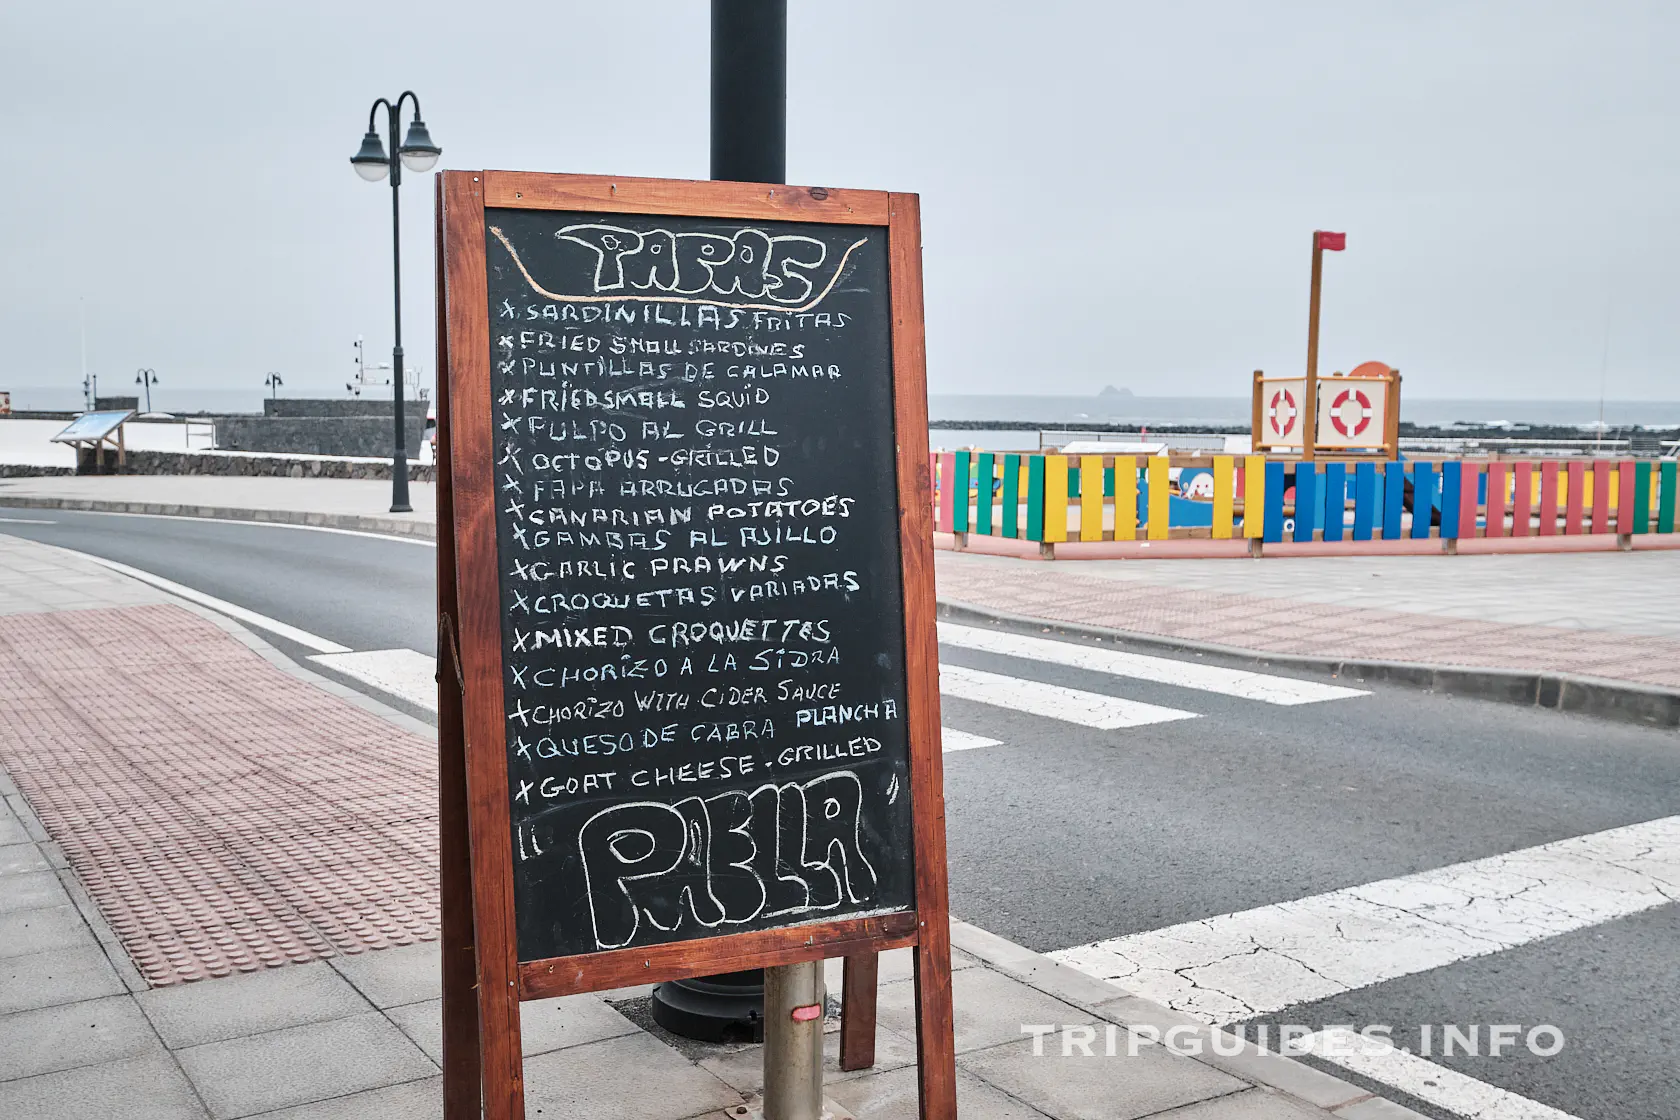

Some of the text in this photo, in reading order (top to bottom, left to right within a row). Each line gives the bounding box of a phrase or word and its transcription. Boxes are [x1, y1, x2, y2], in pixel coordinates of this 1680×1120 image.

[526, 303, 747, 331] SARDINILLAS
[520, 331, 601, 354] FRIED
[684, 362, 715, 382] DE
[727, 363, 842, 380] CALAMAR
[642, 420, 685, 441] AL
[695, 419, 778, 437] GRILL
[531, 448, 650, 472] OCTOPUS
[620, 477, 795, 498] ARRUGADAS
[707, 493, 856, 521] POTATOES
[534, 529, 672, 551] GAMBAS
[689, 528, 728, 549] AL
[650, 554, 789, 577] PRAWNS
[534, 586, 717, 614] CROQUETAS
[649, 617, 831, 649] CROQUETTES
[680, 656, 694, 676] A
[708, 652, 737, 672] LA
[634, 689, 690, 712] WITH
[777, 679, 841, 701] SAUCE
[536, 699, 898, 759] QUESO DE CABRA PLANCHA
[540, 772, 617, 798] GOAT
[631, 755, 755, 788] CHEESE
